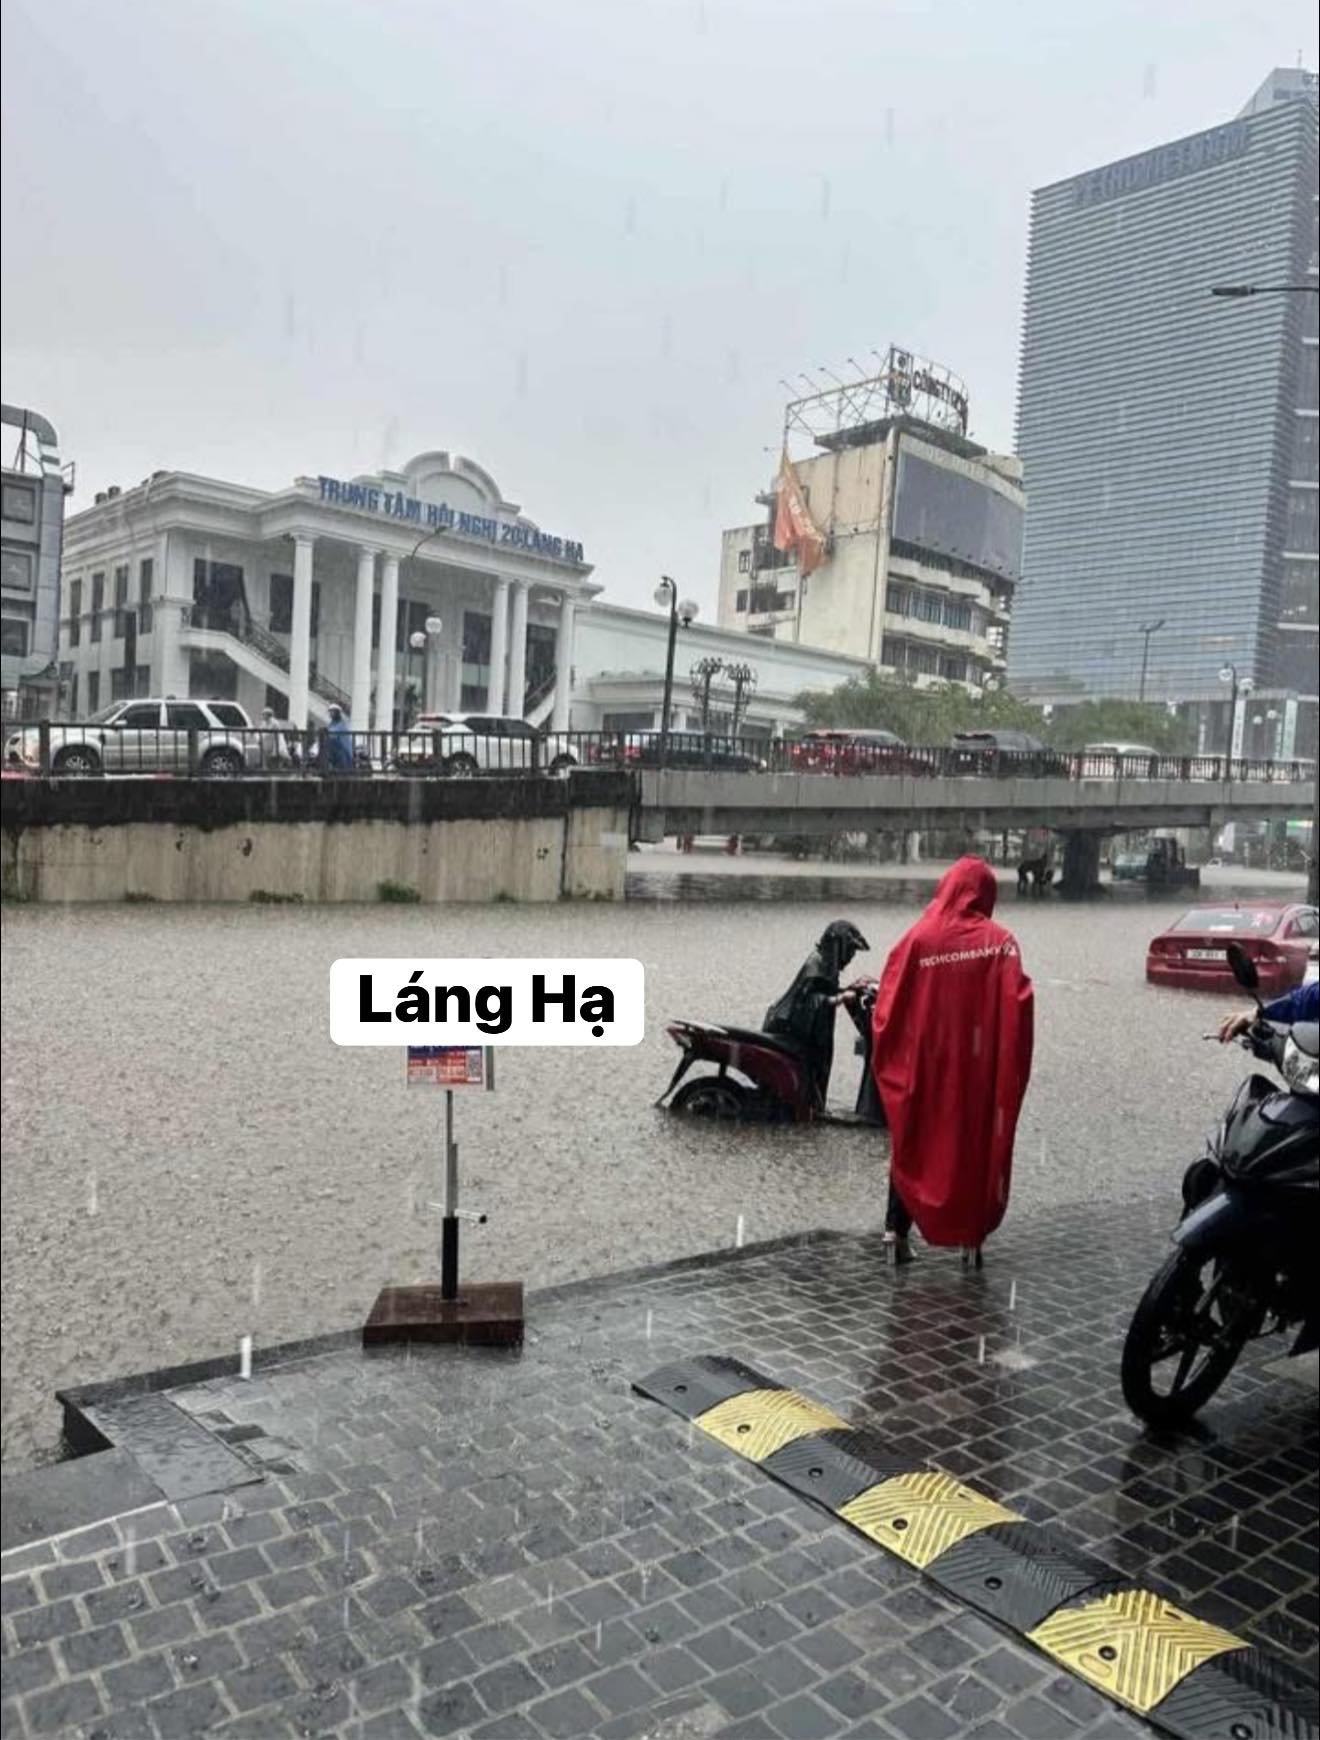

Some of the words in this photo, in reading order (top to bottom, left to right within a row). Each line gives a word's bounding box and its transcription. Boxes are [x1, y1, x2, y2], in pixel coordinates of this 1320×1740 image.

[318, 475, 379, 513] TRUNG
[384, 490, 422, 525] TÂM
[460, 511, 497, 544] NGHỊ
